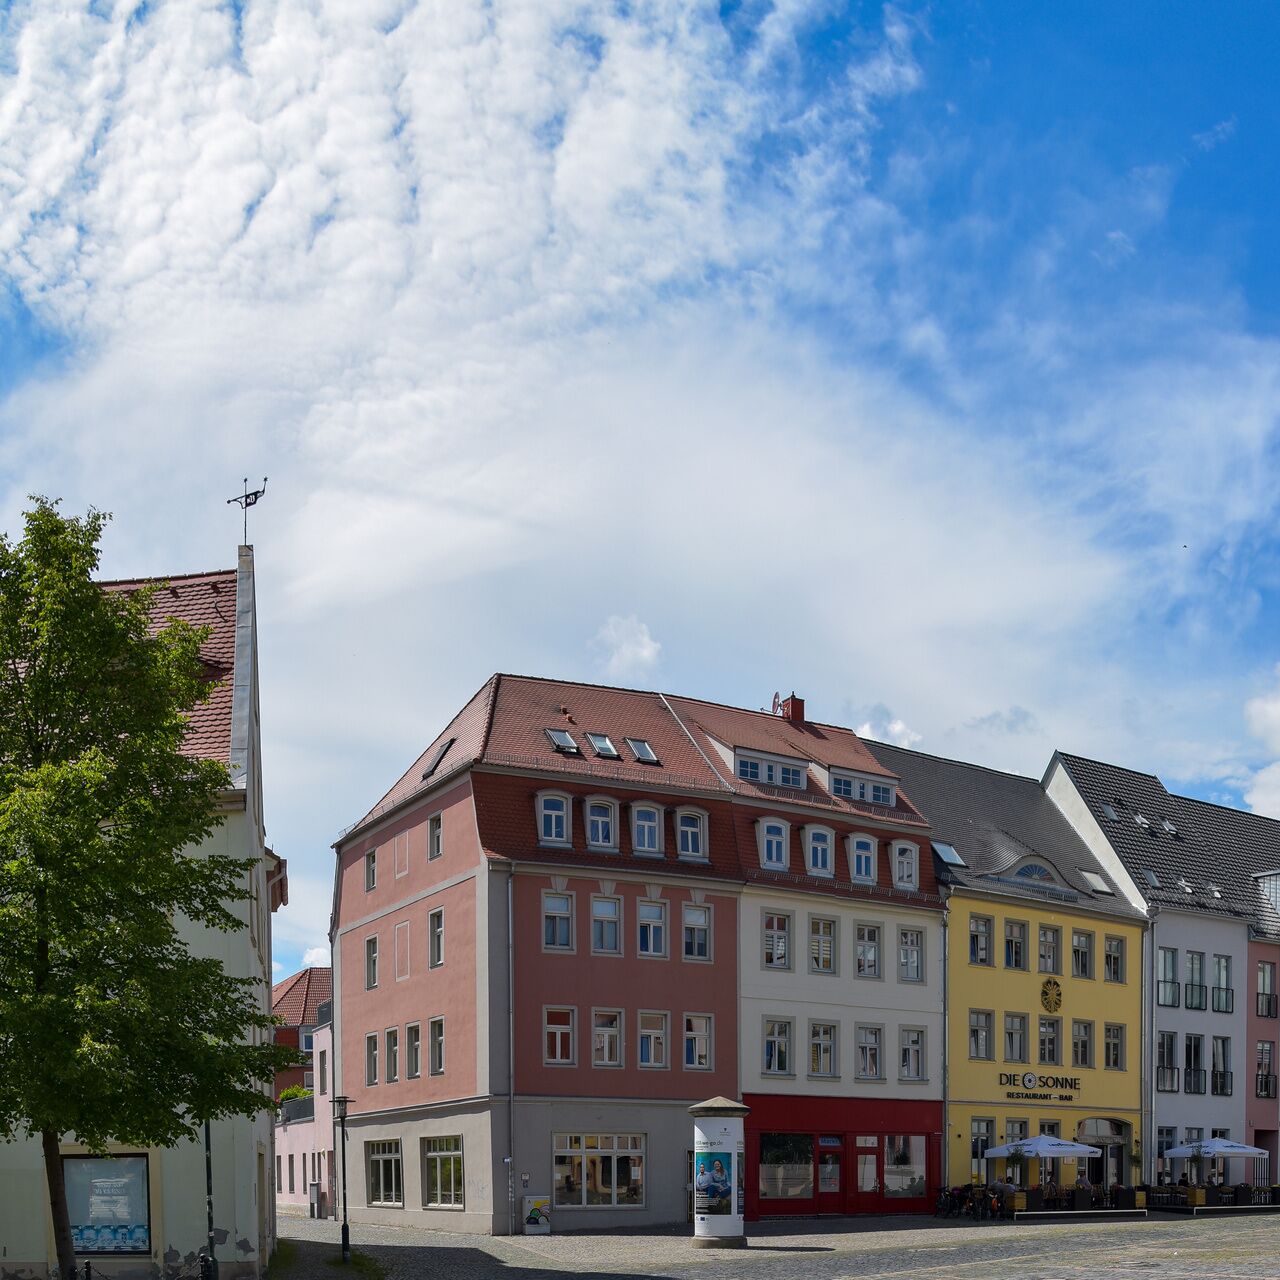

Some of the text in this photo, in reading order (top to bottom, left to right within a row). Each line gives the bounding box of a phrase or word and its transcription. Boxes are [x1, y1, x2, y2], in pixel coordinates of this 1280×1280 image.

[1000, 1073, 1081, 1090] DIE SONNE
[1007, 1092, 1052, 1100] RESTAURANT
